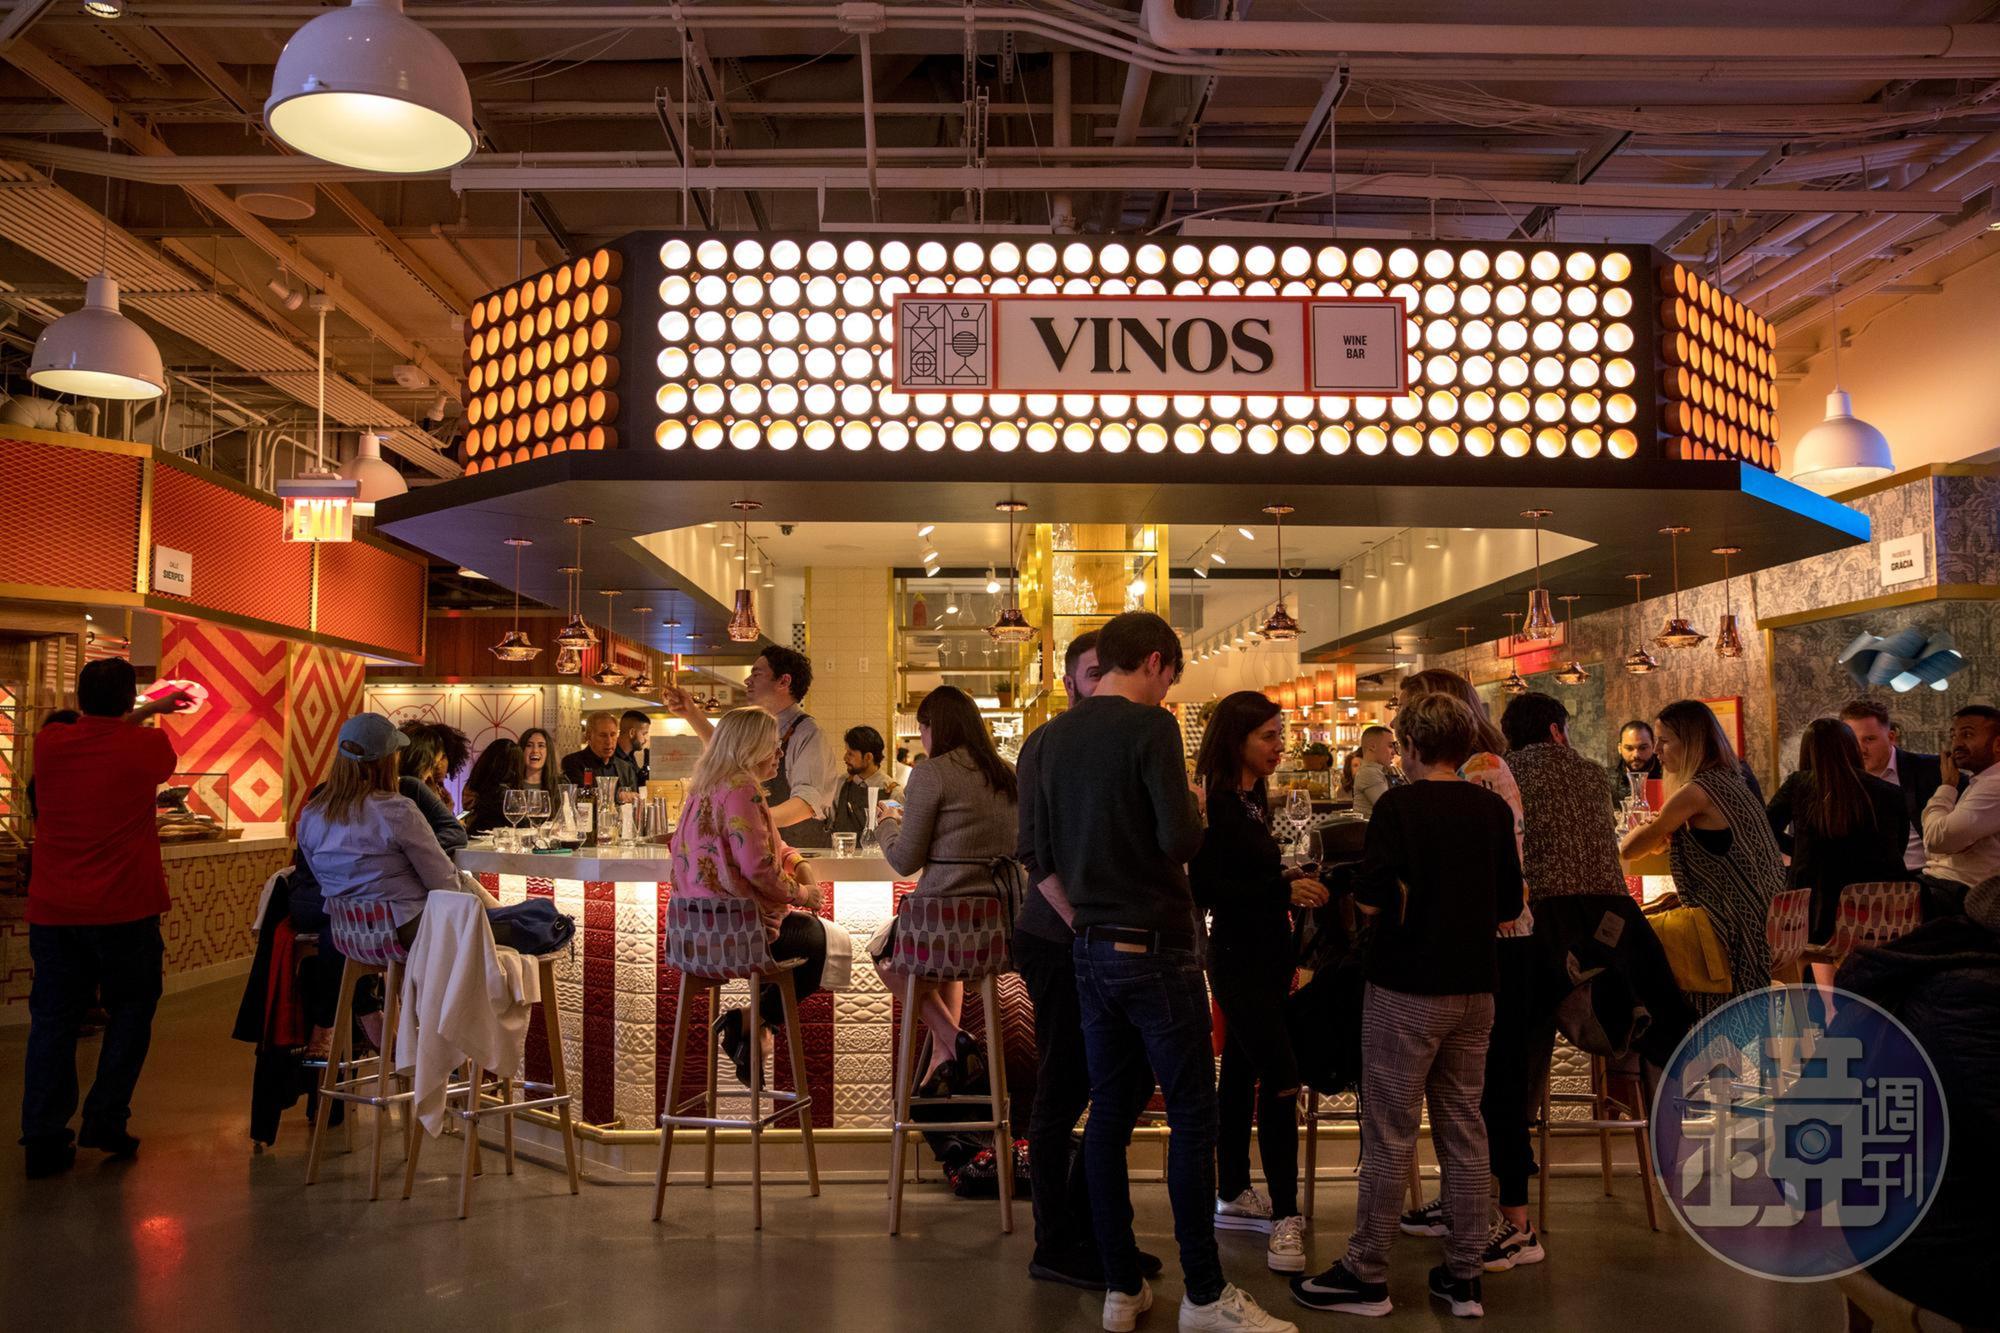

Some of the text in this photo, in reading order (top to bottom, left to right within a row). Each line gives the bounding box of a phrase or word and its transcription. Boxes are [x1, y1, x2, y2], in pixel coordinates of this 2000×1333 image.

[1030, 316, 1275, 375] VINOS
[1343, 335, 1368, 346] WINE
[1346, 348, 1366, 359] BAR
[294, 499, 348, 538] EXIT
[163, 569, 185, 583] SIERPES
